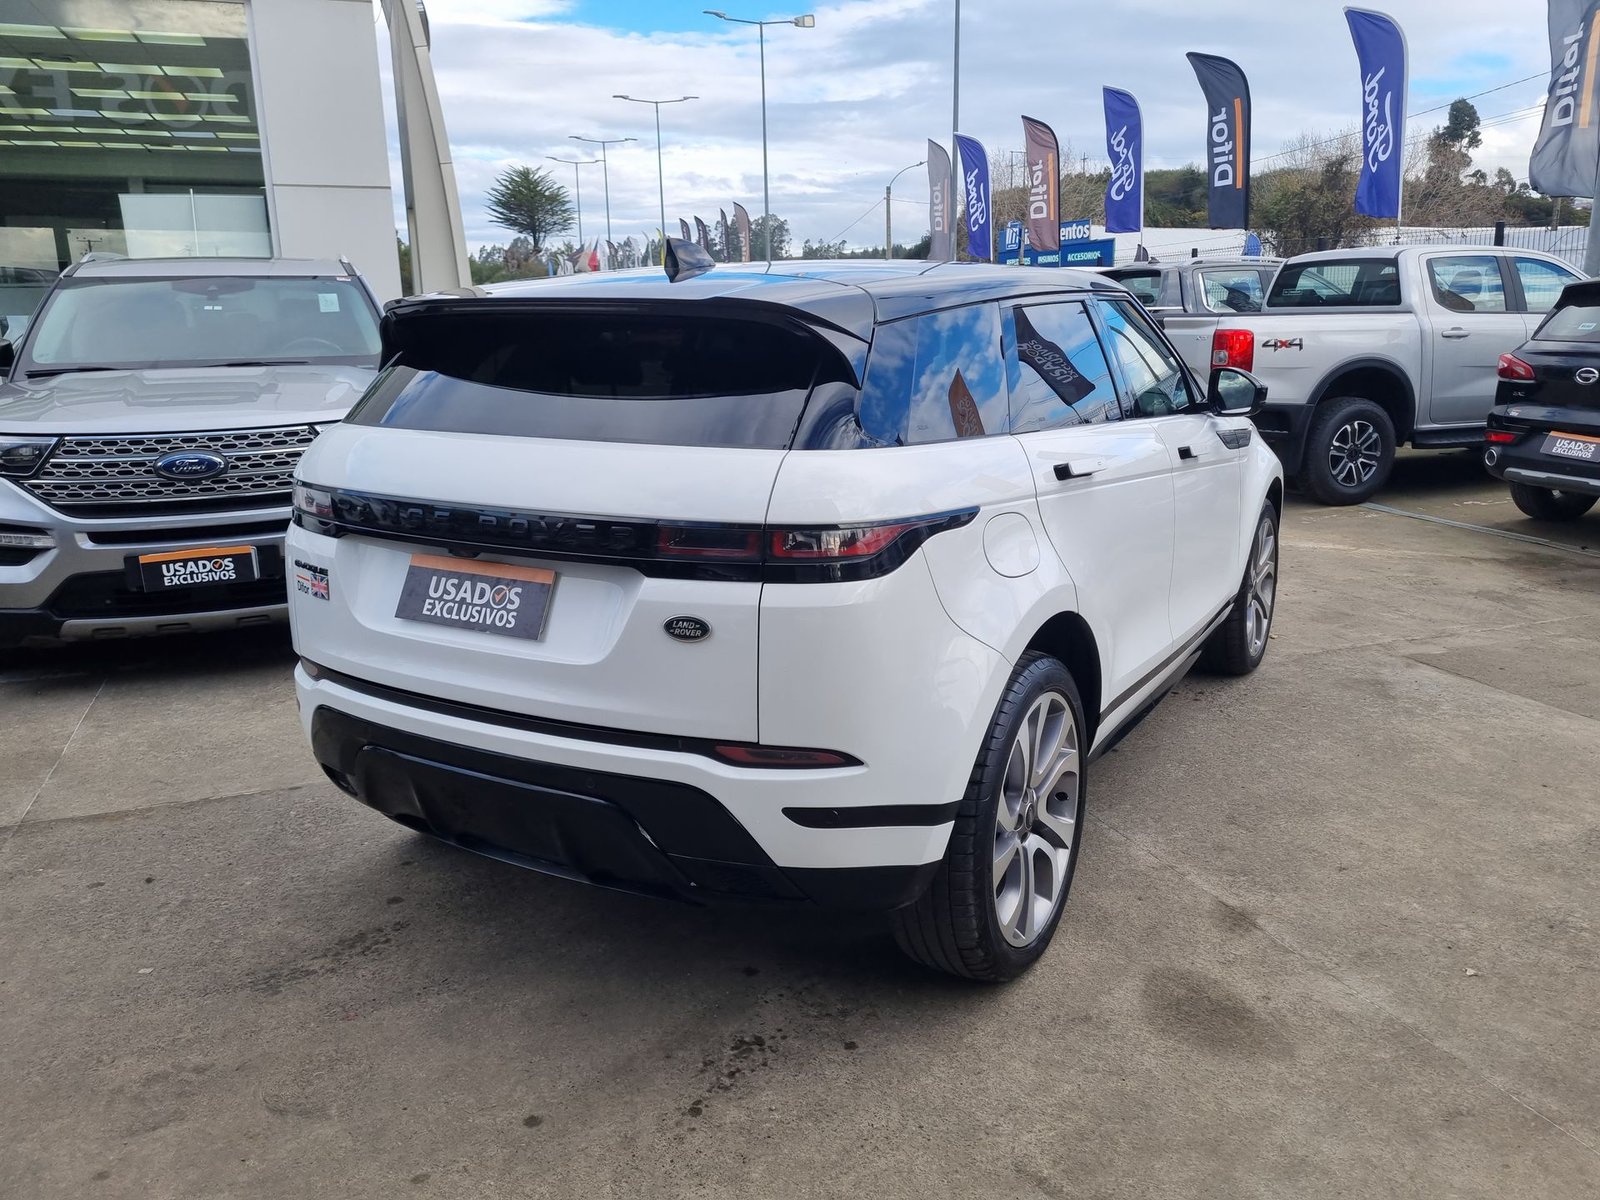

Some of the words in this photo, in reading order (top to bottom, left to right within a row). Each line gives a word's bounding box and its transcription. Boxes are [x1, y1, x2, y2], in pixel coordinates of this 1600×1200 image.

[1552, 446, 1592, 458] EXCLUSIVOS
[1556, 439, 1597, 453] USADOS
[172, 459, 208, 473] Ford
[161, 557, 235, 577] USADOS
[163, 569, 237, 586] EXCLUSIVOS
[428, 575, 523, 610] USADOS
[422, 598, 517, 628] EXCLUSIVOS
